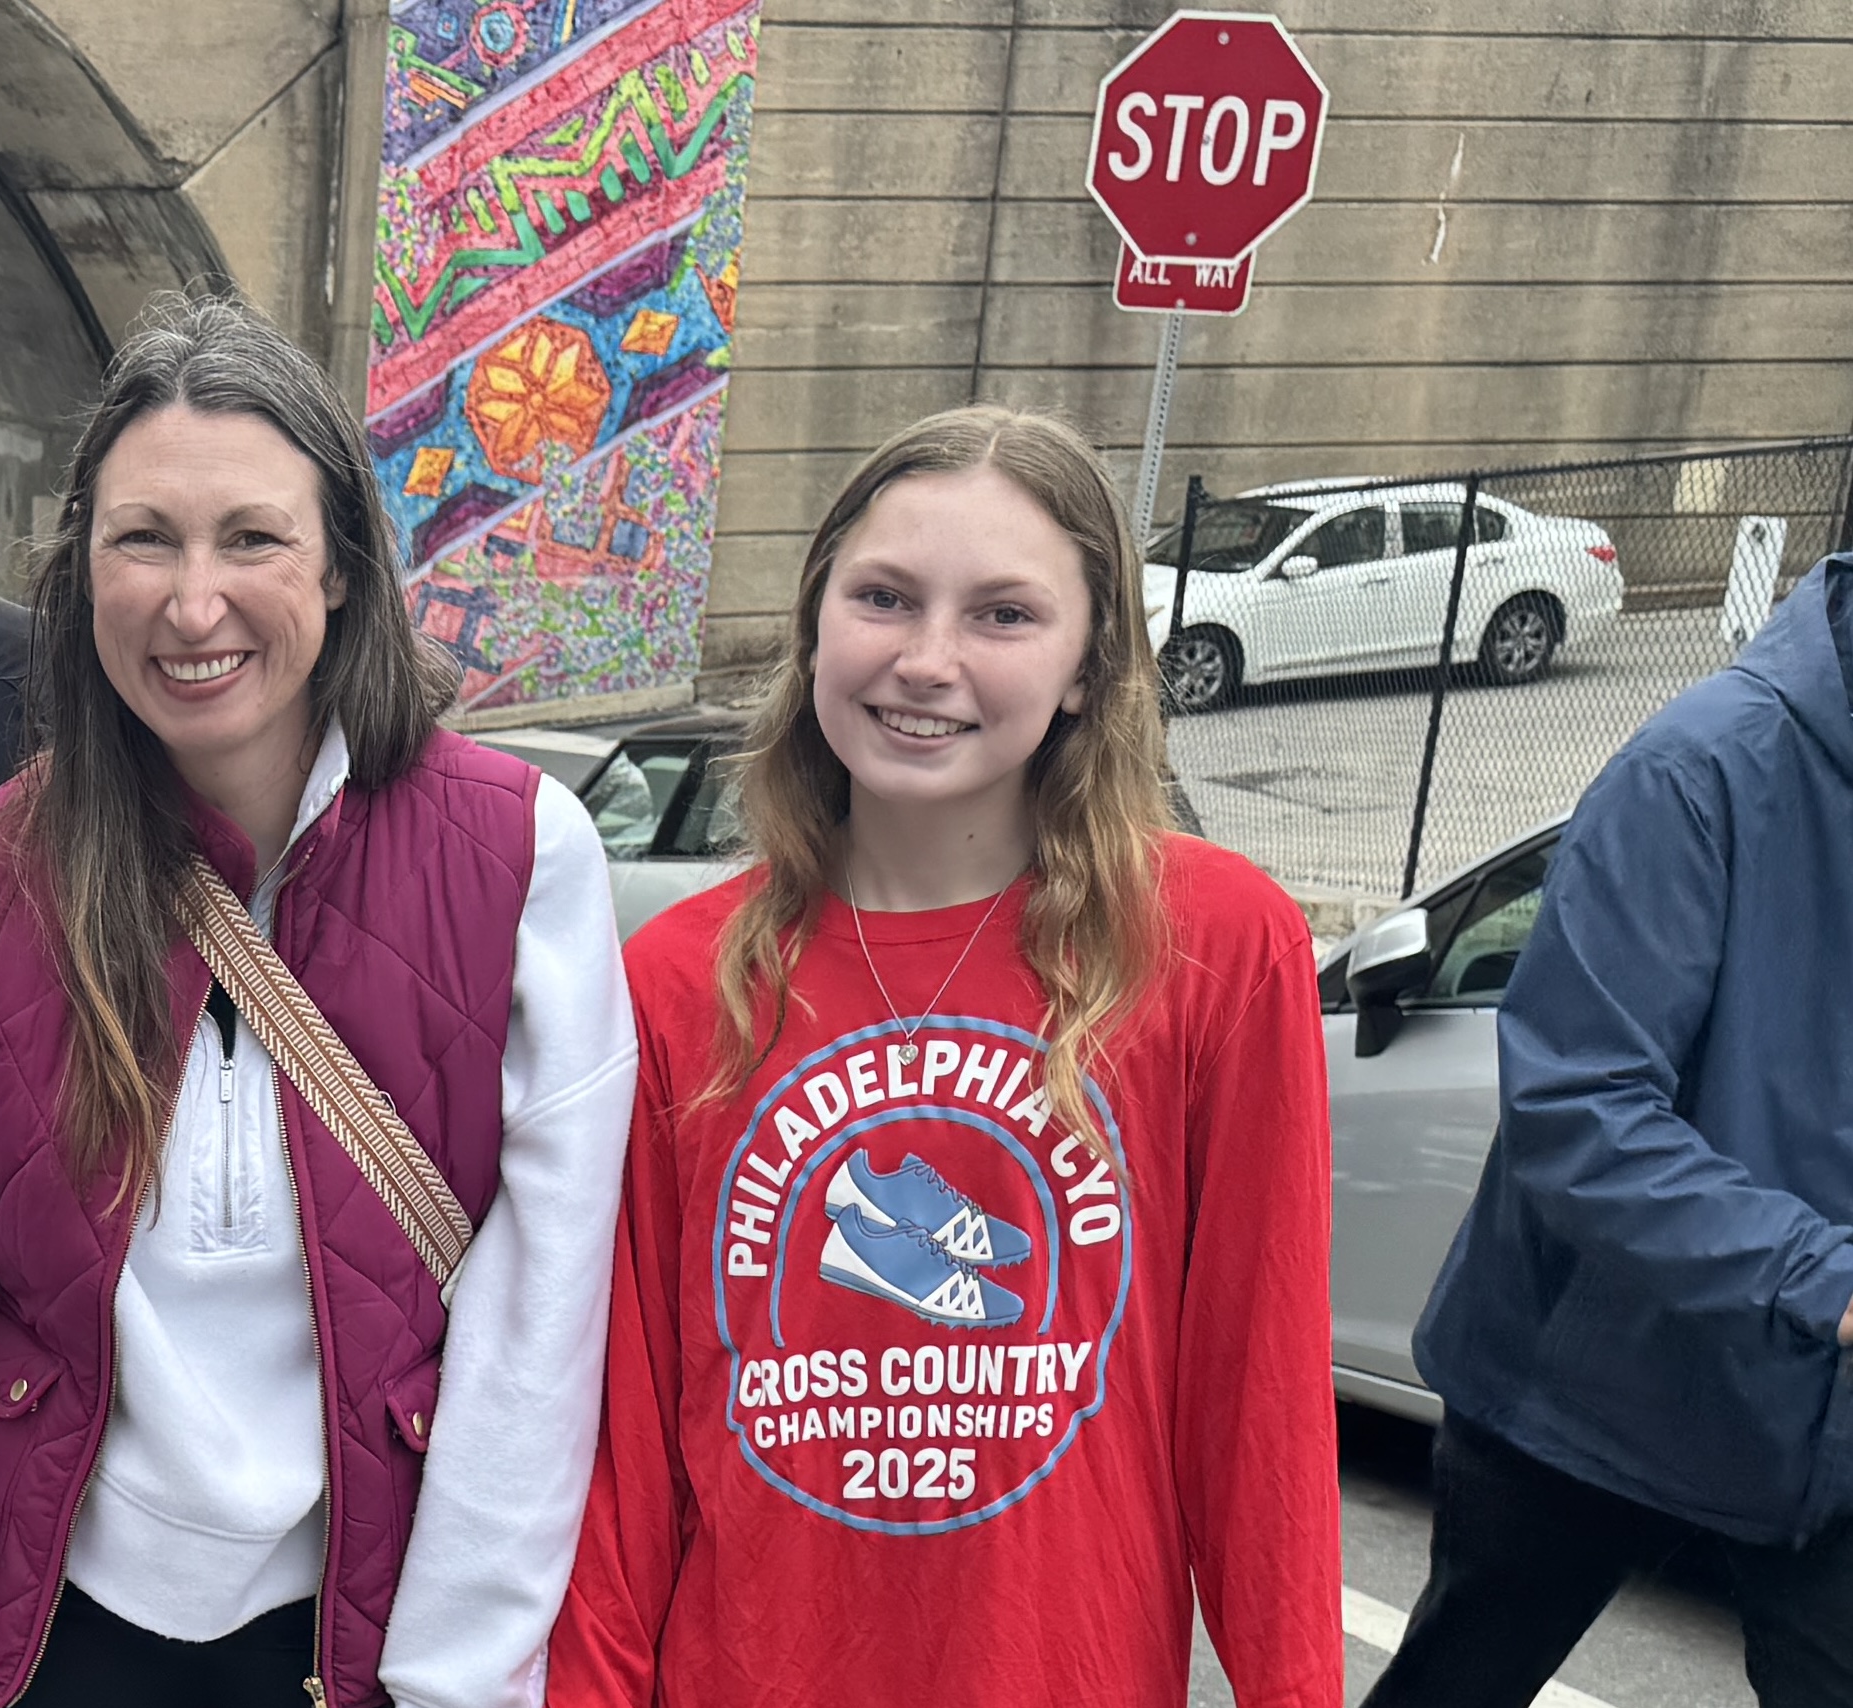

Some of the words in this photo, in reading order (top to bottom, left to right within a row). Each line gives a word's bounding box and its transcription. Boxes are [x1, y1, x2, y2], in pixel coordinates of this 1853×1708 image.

[1107, 91, 1307, 186] STOP
[1128, 258, 1172, 286] ALL
[1195, 262, 1241, 289] WAY
[728, 1040, 1054, 1278] PHILADELPHIA
[1050, 1130, 1121, 1246] CYO
[738, 1348, 868, 1409] CROSS
[880, 1341, 1093, 1396] COUNTRY
[754, 1402, 1055, 1450] CHAMPIONSHIPS
[842, 1448, 977, 1501] 2025
